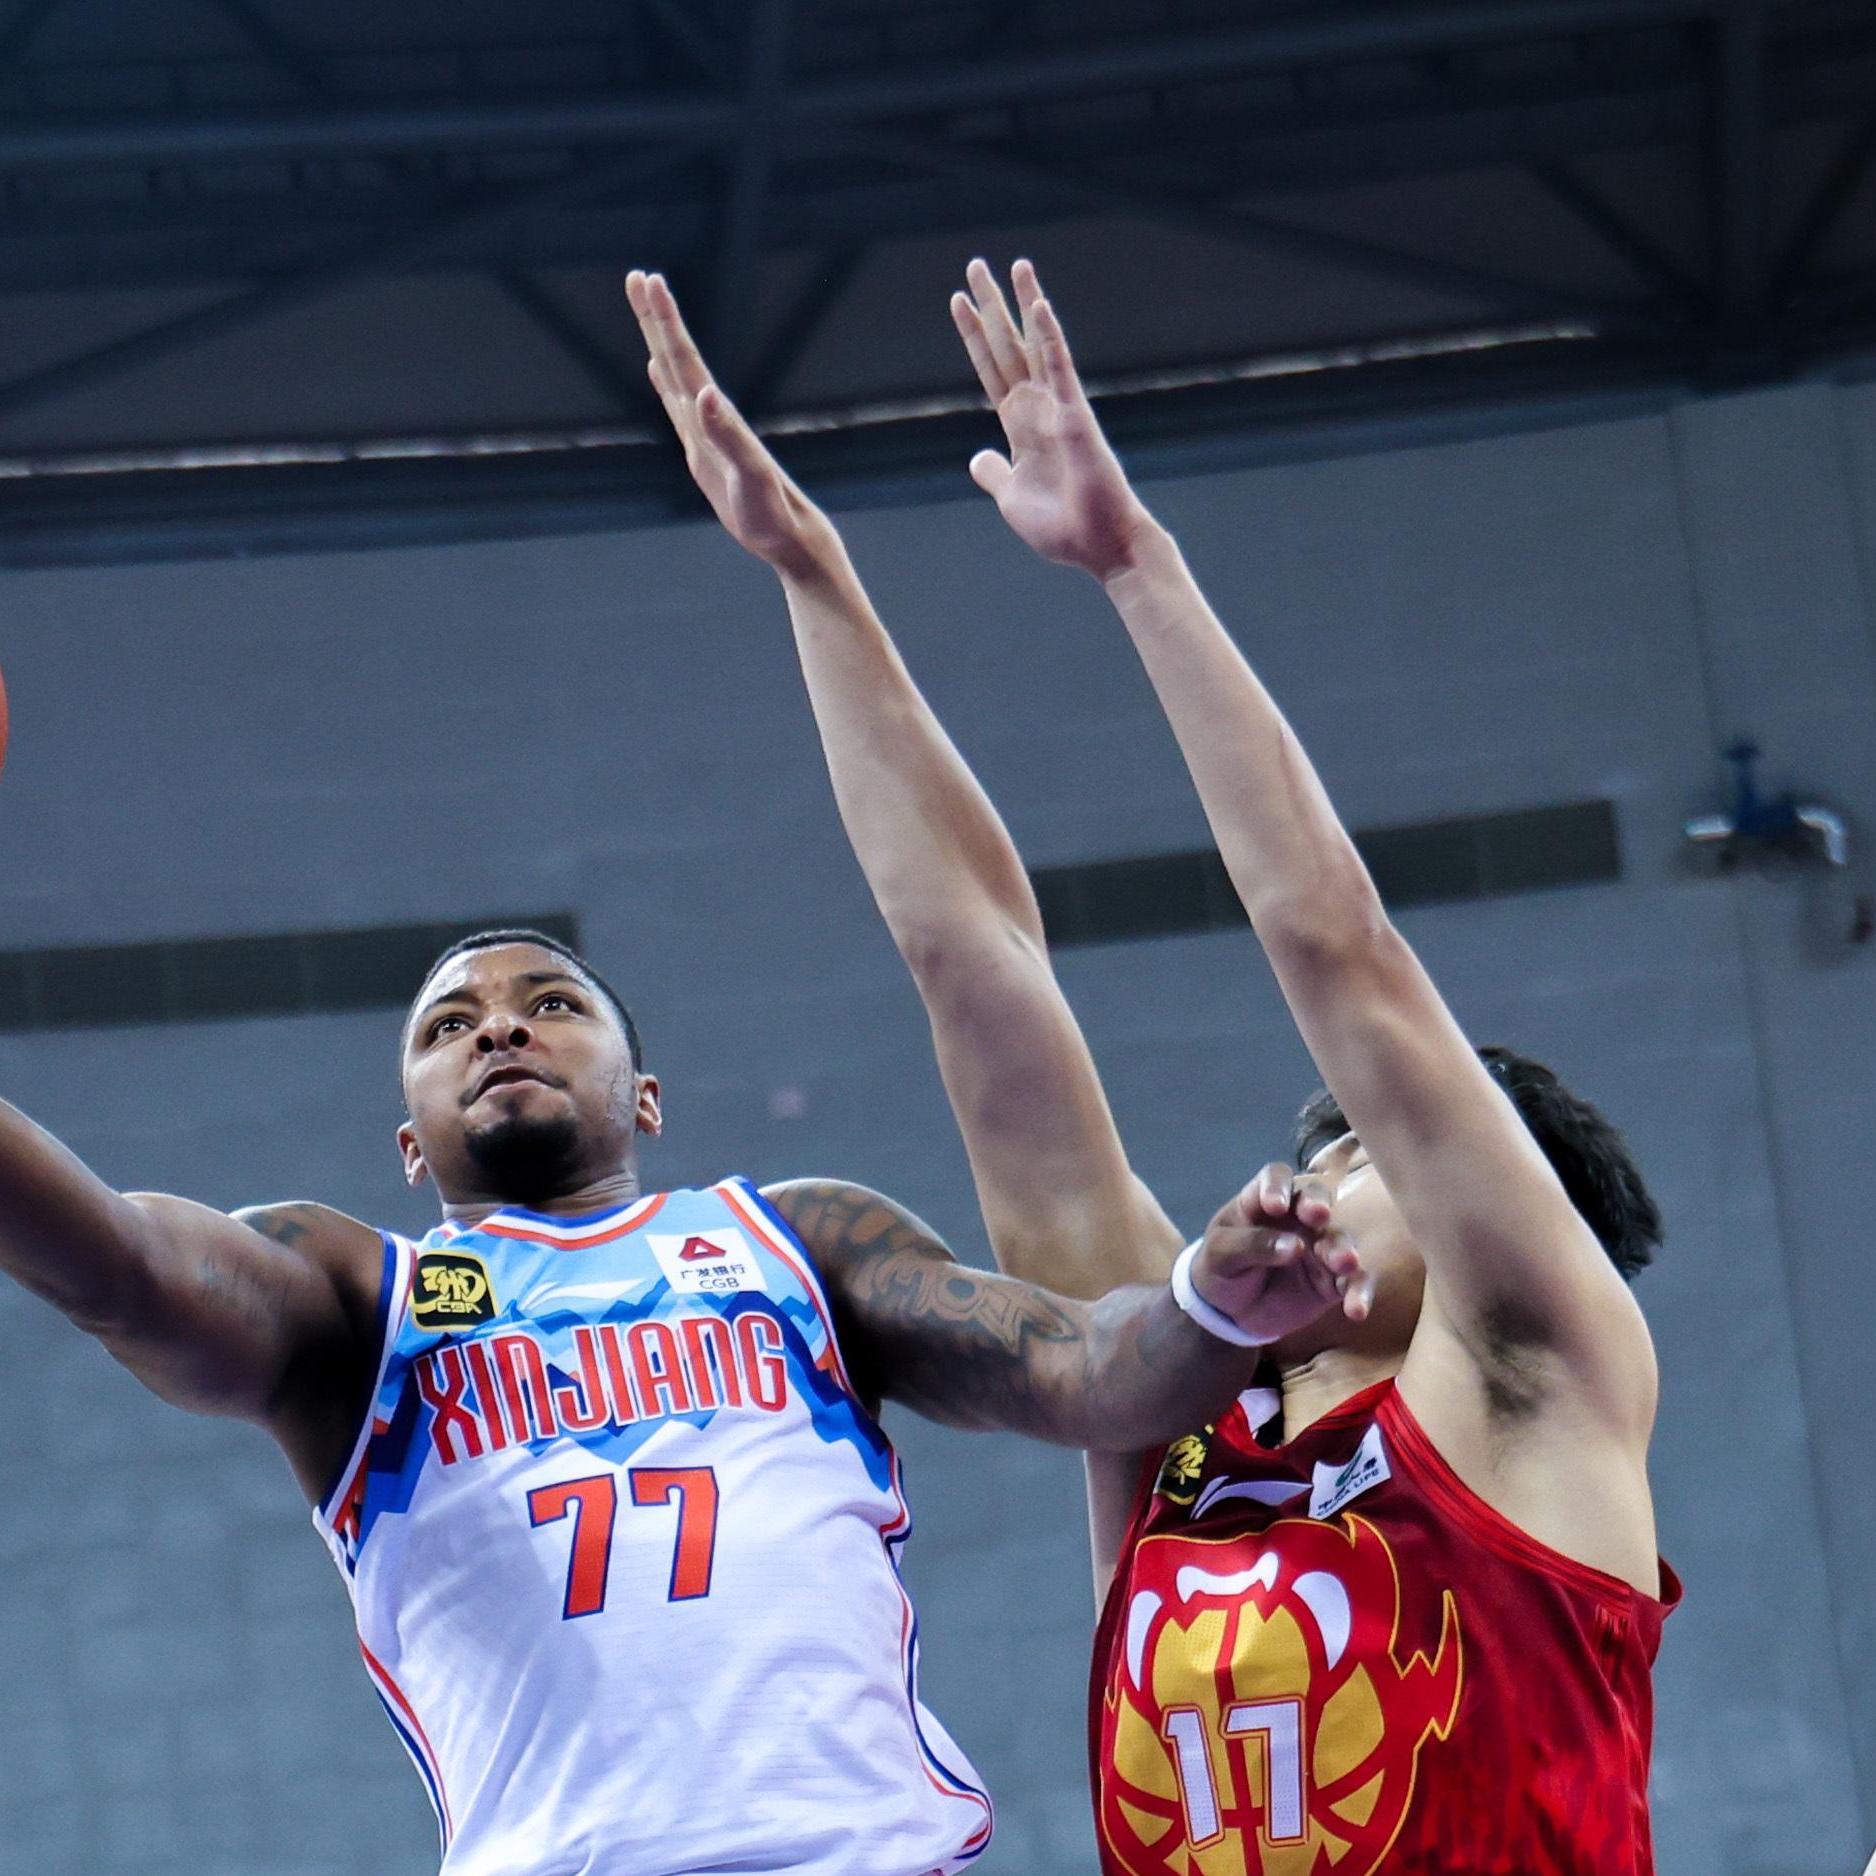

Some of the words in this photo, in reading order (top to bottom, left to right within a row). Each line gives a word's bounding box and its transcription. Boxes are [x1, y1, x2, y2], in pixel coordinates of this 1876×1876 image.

[699, 1277, 740, 1290] CGB
[412, 1311, 788, 1466] XINJIANG
[527, 1465, 721, 1621] 77
